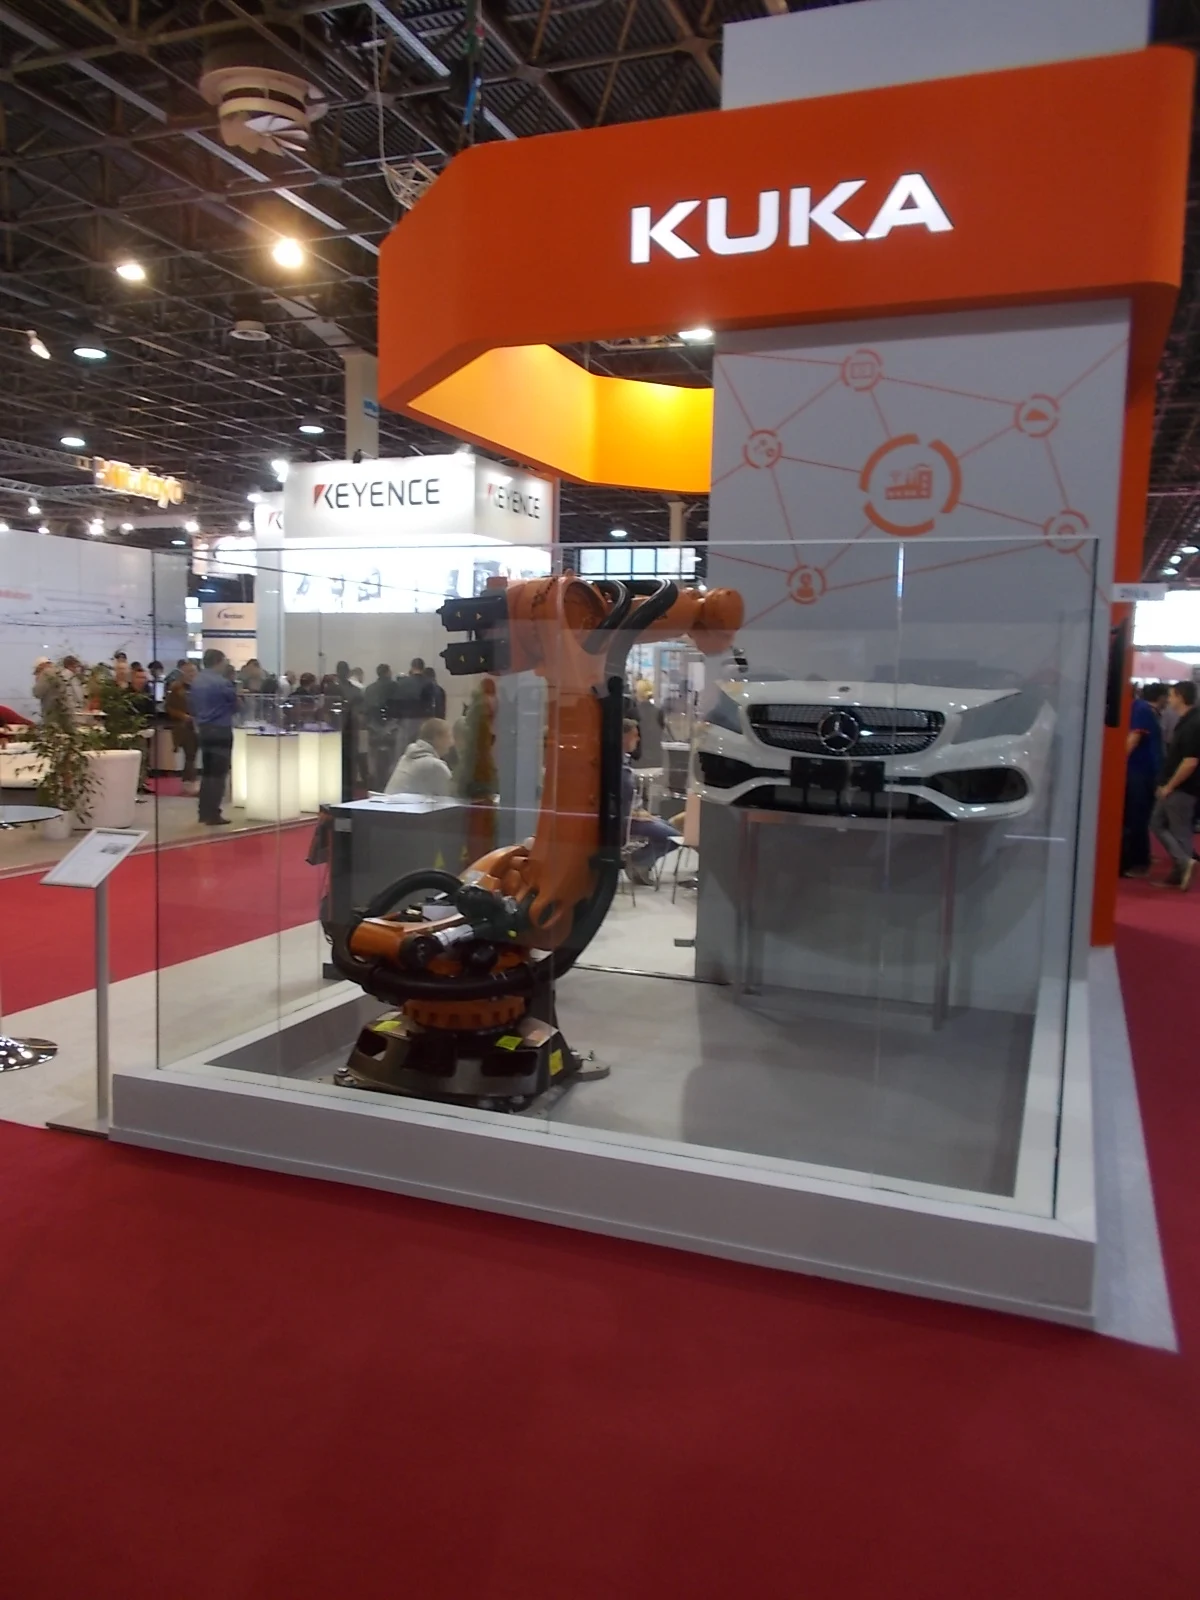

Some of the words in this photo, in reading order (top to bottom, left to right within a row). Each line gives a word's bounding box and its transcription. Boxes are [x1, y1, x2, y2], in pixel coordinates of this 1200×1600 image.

[630, 172, 954, 264] KUKA
[313, 478, 440, 508] KEYENCE
[487, 483, 540, 519] KEYENCE
